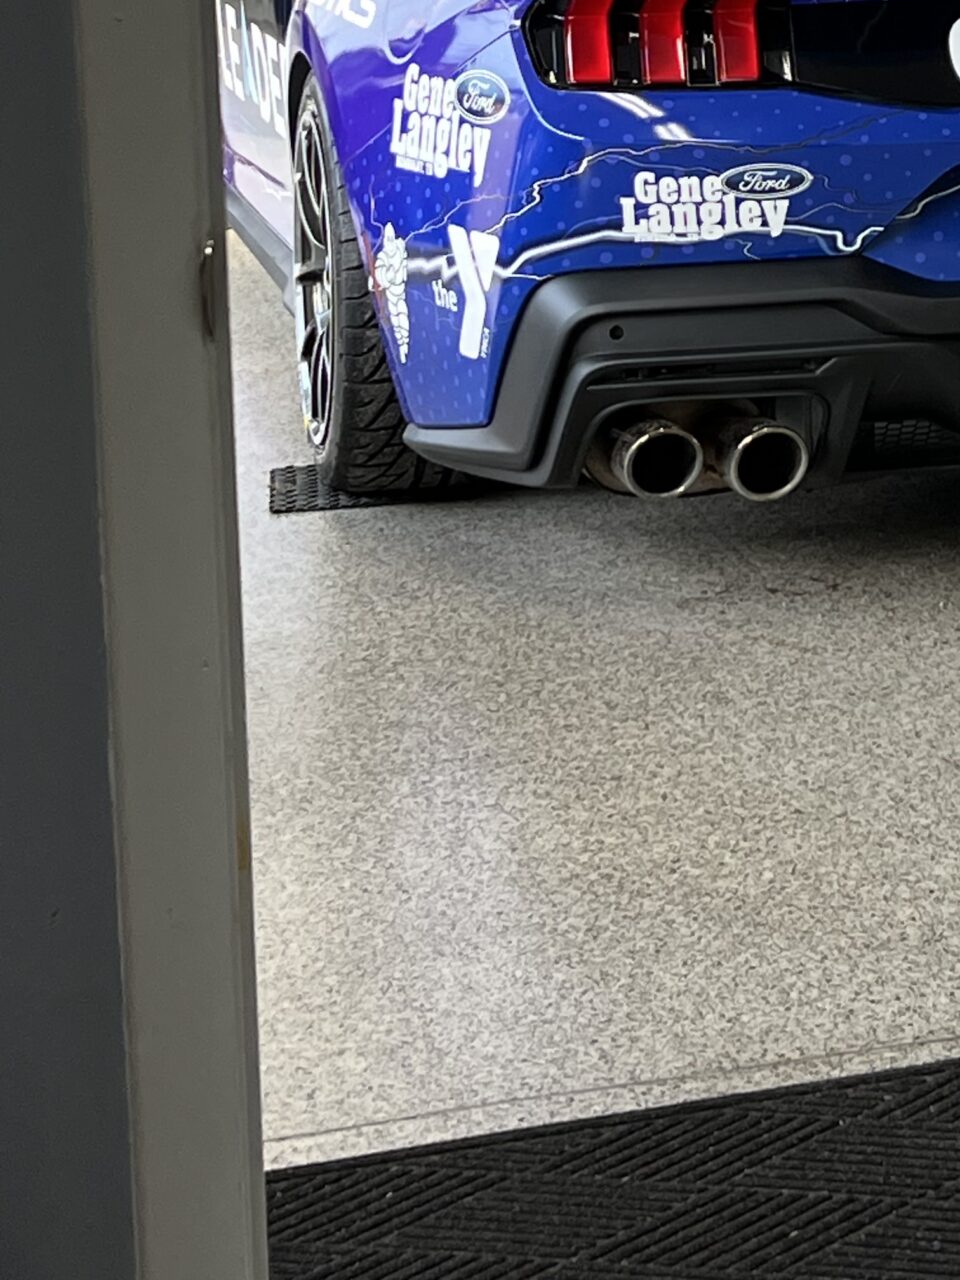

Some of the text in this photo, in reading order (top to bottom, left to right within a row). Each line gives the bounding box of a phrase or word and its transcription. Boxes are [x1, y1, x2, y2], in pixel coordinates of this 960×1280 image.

[403, 63, 457, 119] Gene
[463, 79, 497, 114] Ford
[390, 111, 491, 187] Langley
[634, 171, 722, 204] Gene
[738, 171, 791, 191] Ford
[620, 193, 790, 240] Langley
[432, 224, 499, 359] the Y
